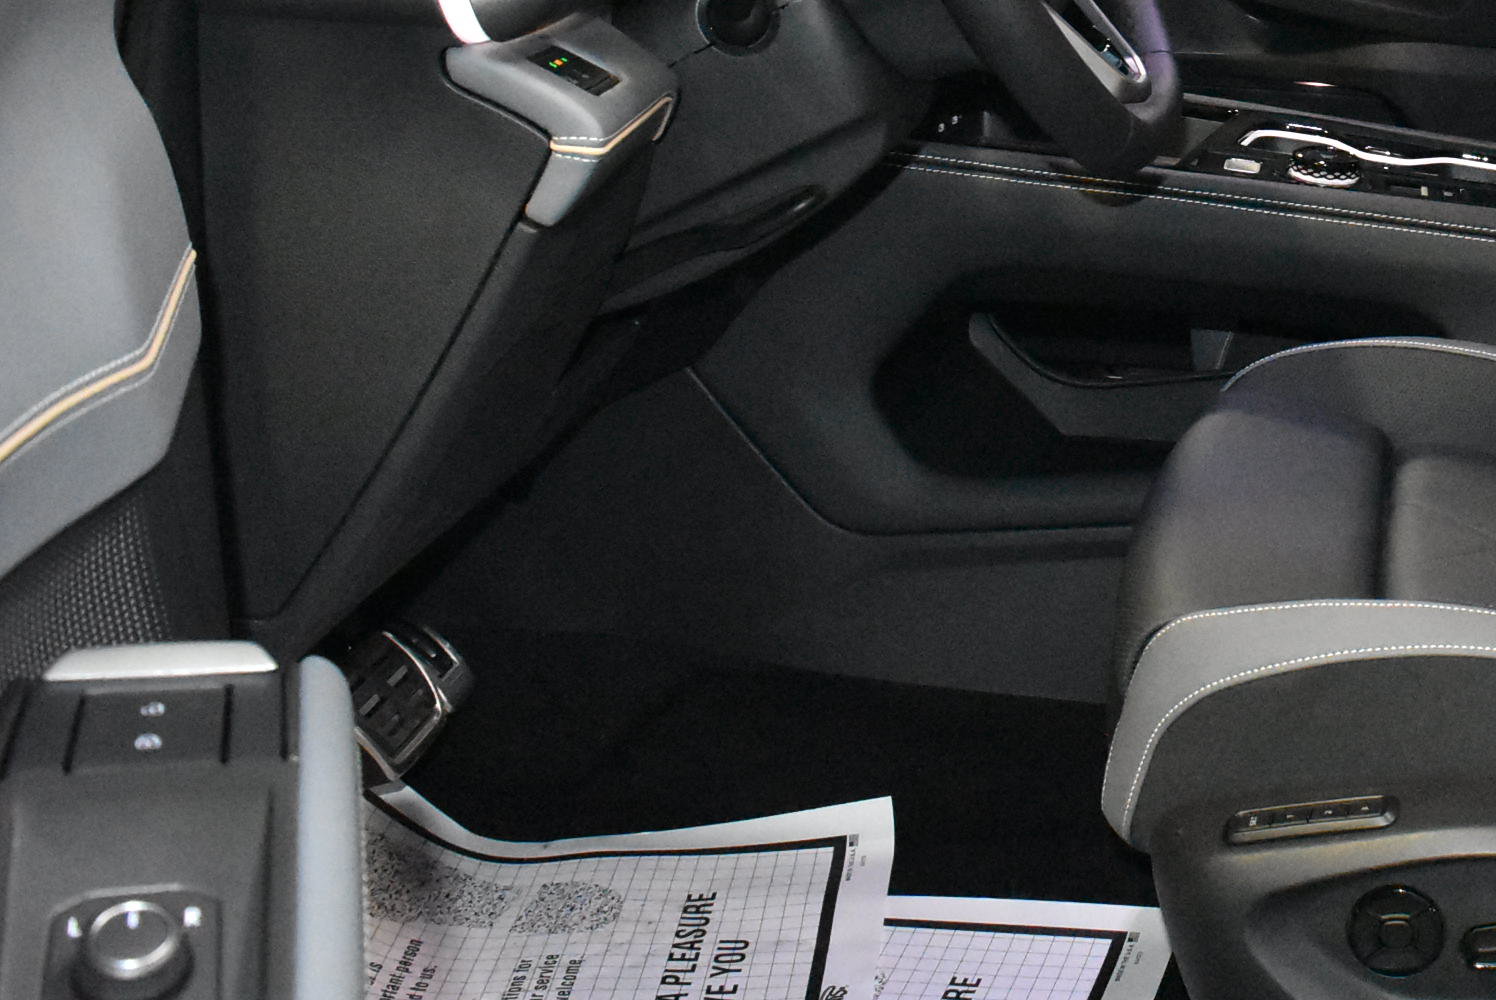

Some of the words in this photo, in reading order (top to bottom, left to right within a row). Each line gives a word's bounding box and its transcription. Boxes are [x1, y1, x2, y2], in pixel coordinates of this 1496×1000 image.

[395, 938, 424, 974] person
[660, 891, 717, 985] PLEASURE
[513, 959, 533, 973] for
[534, 954, 560, 990] service
[709, 939, 750, 978] YOU
[409, 981, 430, 992] to
